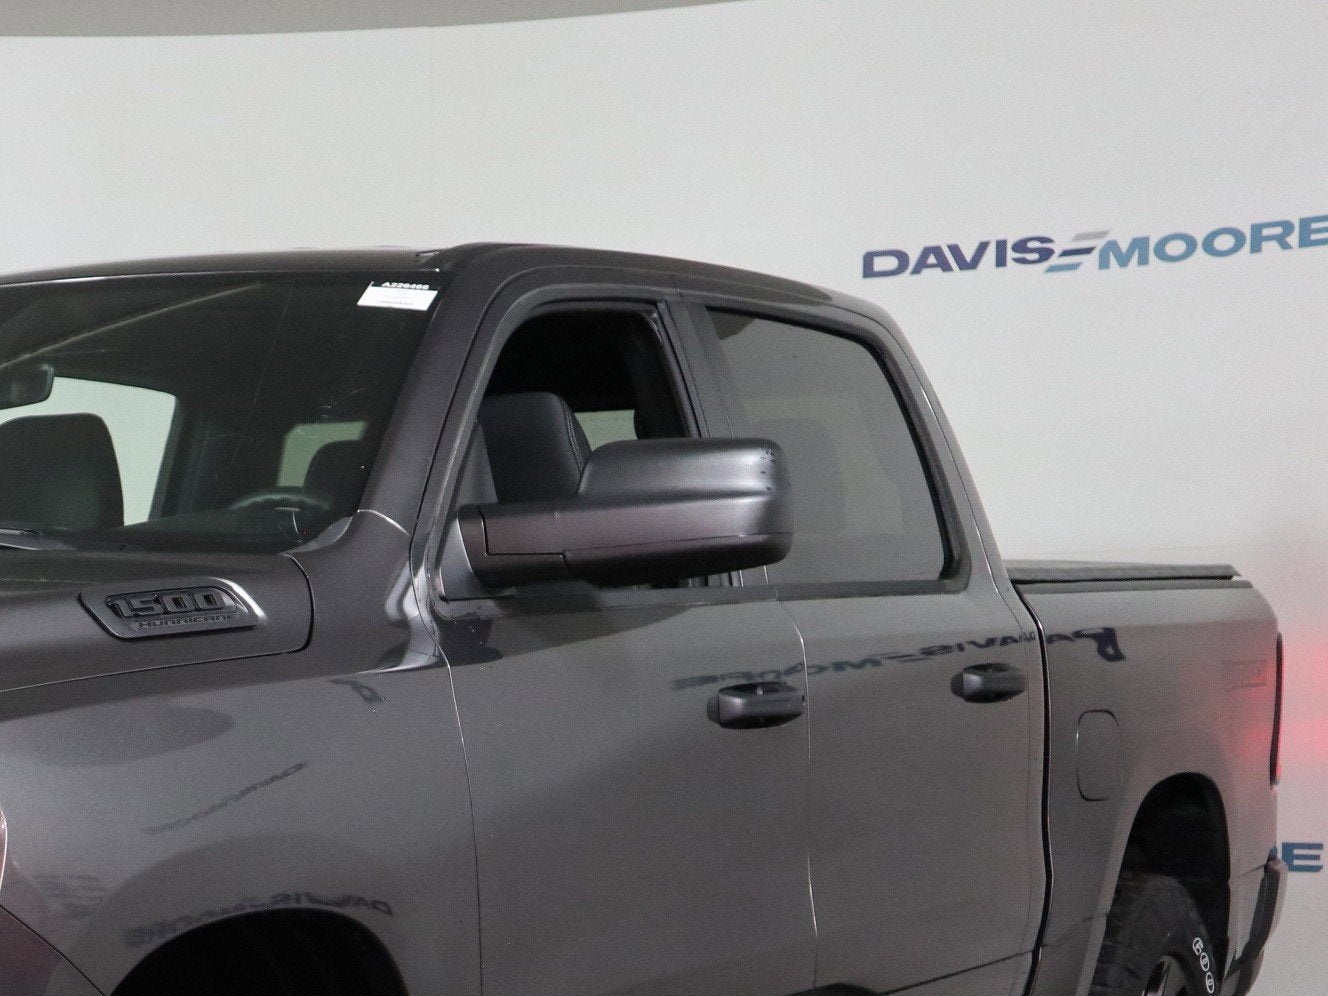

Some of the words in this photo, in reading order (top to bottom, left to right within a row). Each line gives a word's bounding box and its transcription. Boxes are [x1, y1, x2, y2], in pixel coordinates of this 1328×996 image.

[862, 236, 1055, 279] DAVIS
[1098, 214, 1328, 270] MOORE
[107, 587, 236, 619] 1500
